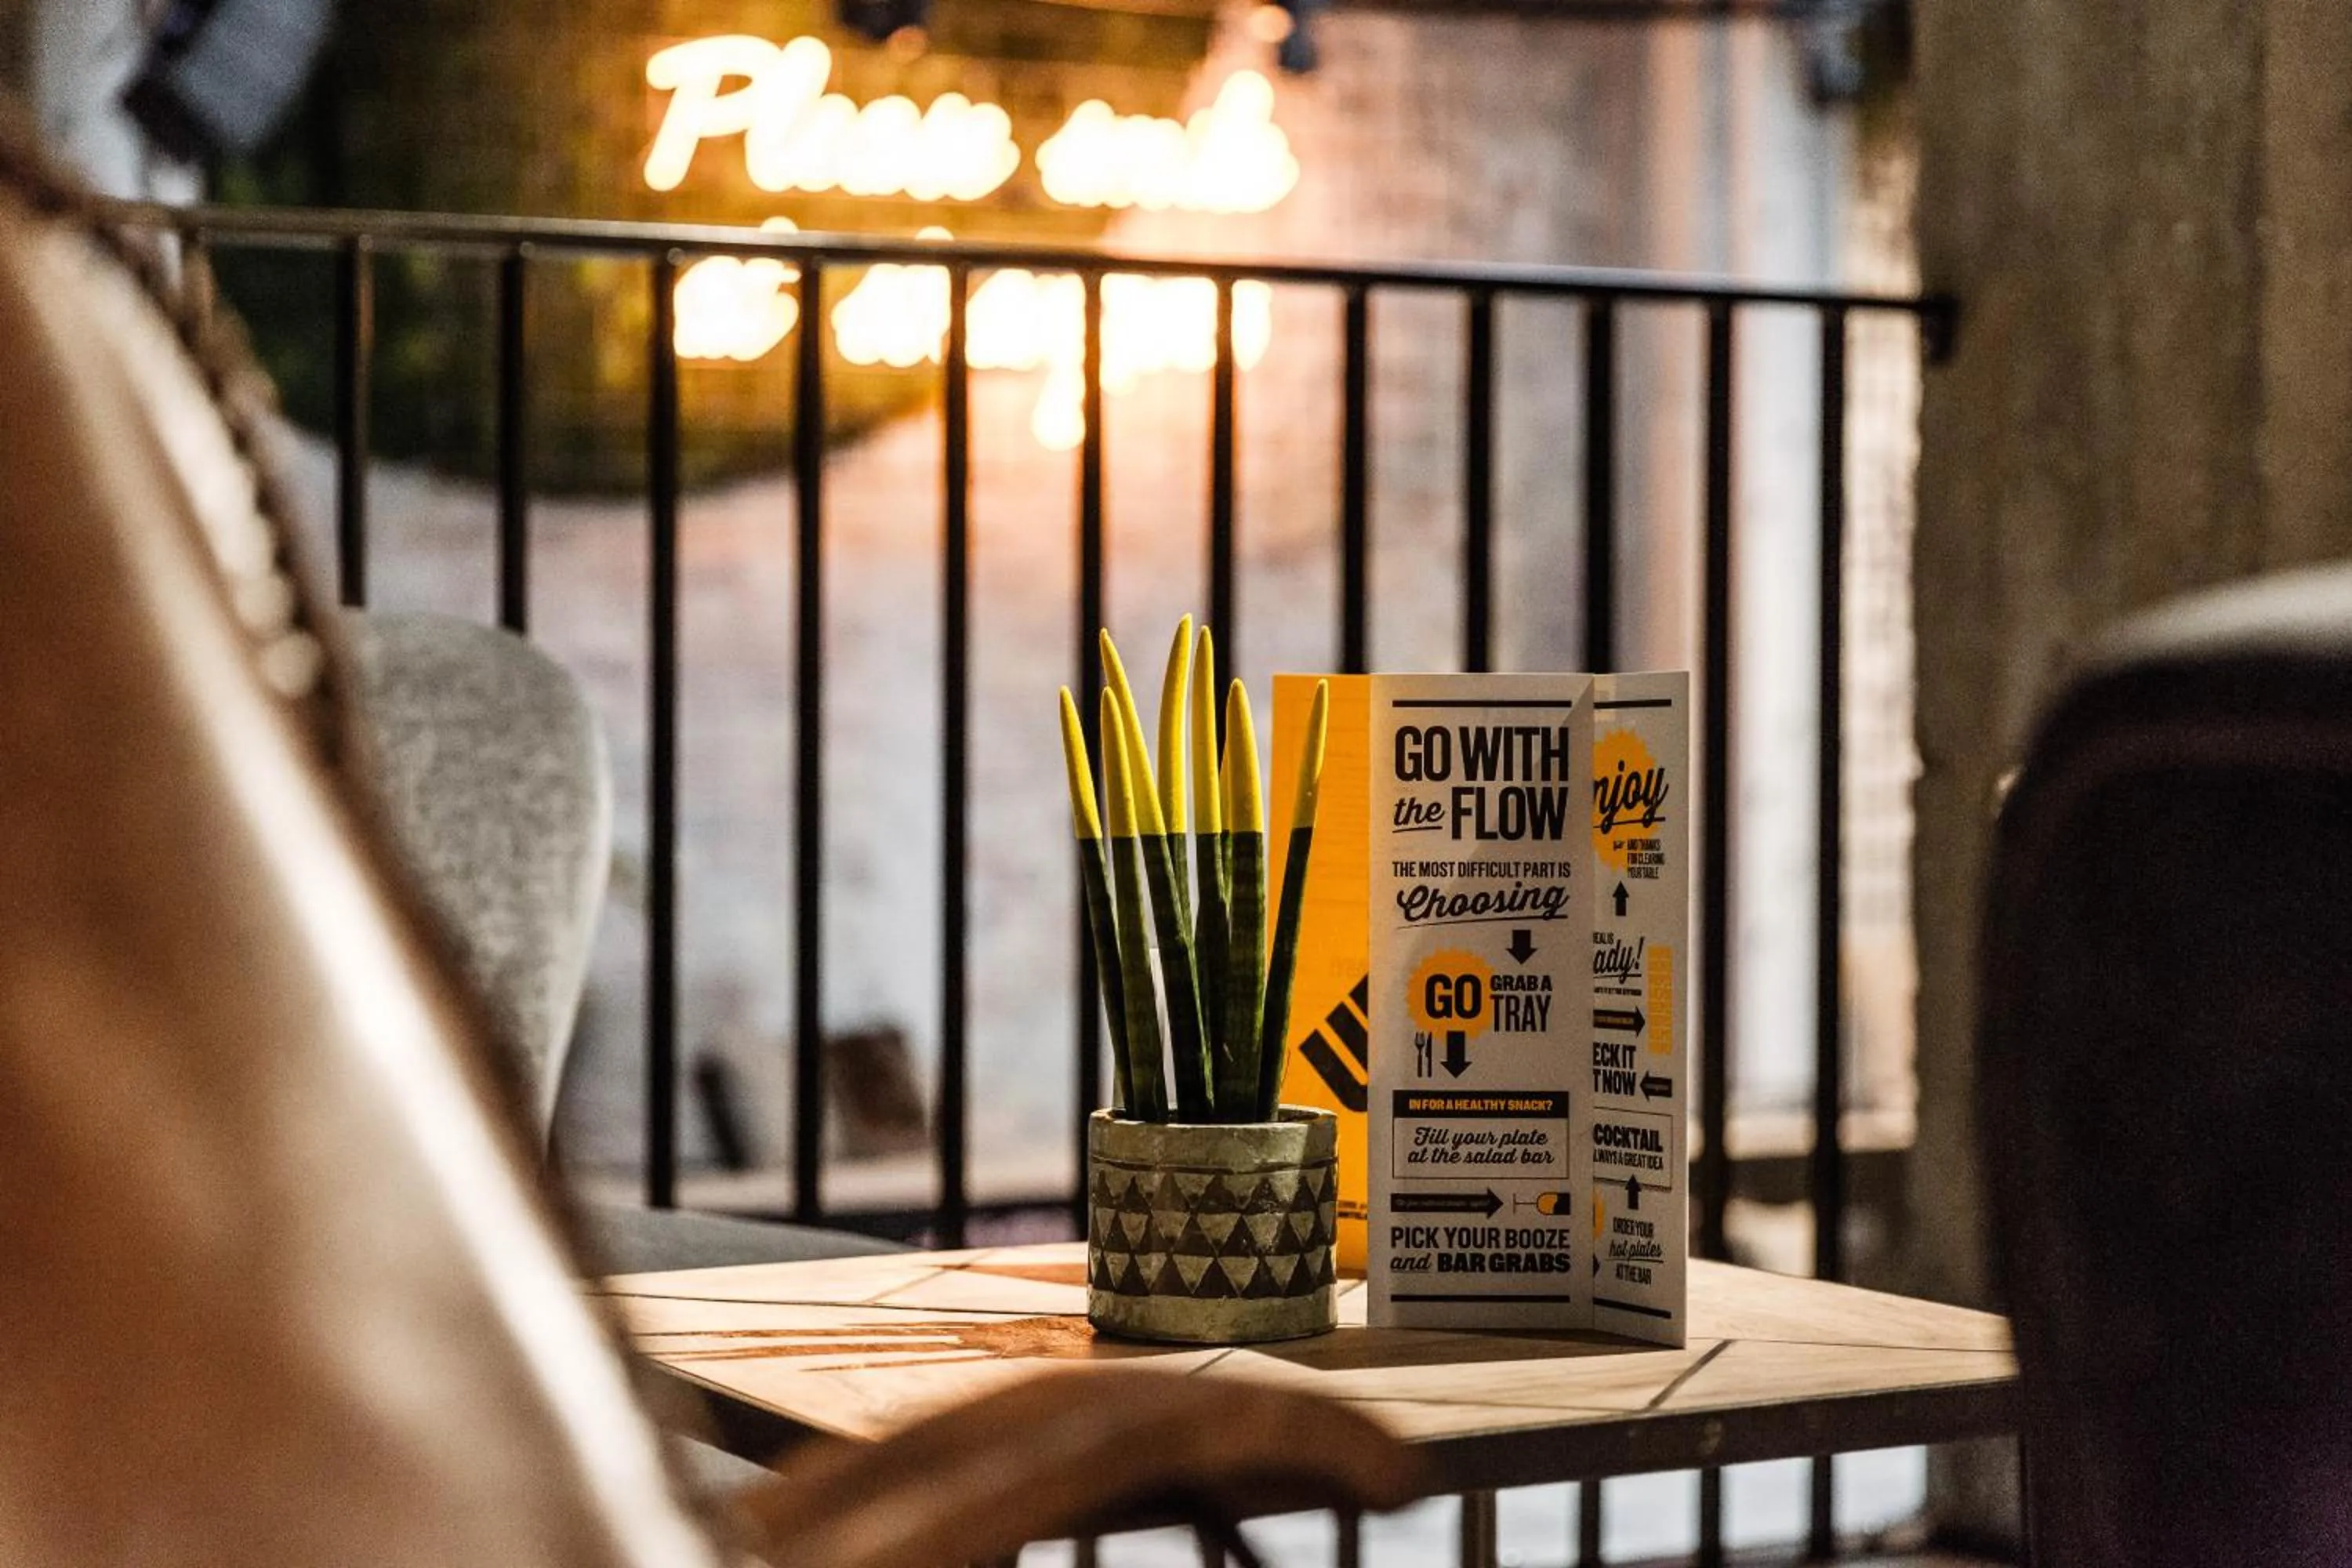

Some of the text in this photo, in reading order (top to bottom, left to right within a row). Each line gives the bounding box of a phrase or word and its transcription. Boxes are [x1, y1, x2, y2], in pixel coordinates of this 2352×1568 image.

[1395, 726, 1569, 782] GO WITH
[1392, 786, 1568, 840] the FLOW
[1392, 862, 1571, 877] THE MOST DIFFICULT PART IS
[1396, 881, 1570, 922] Choosing
[1490, 975, 1553, 992] GRAB A
[1425, 974, 1483, 1019] GO
[1490, 994, 1552, 1032] TRAY
[1622, 1044, 1637, 1069] IT
[1602, 1069, 1637, 1096] NOW
[1421, 1099, 1443, 1110] FOR
[1443, 1099, 1454, 1110] A
[1455, 1099, 1506, 1111] HEALTHY
[1508, 1099, 1553, 1111] SNACK?
[1414, 1127, 1548, 1151] Fill your plate
[1593, 1123, 1663, 1152] COCKTAIL
[1408, 1146, 1554, 1163] at the salad bar
[1391, 1227, 1570, 1249] PICK YOUR BOOZE
[1390, 1253, 1571, 1273] and BAR GRABS
